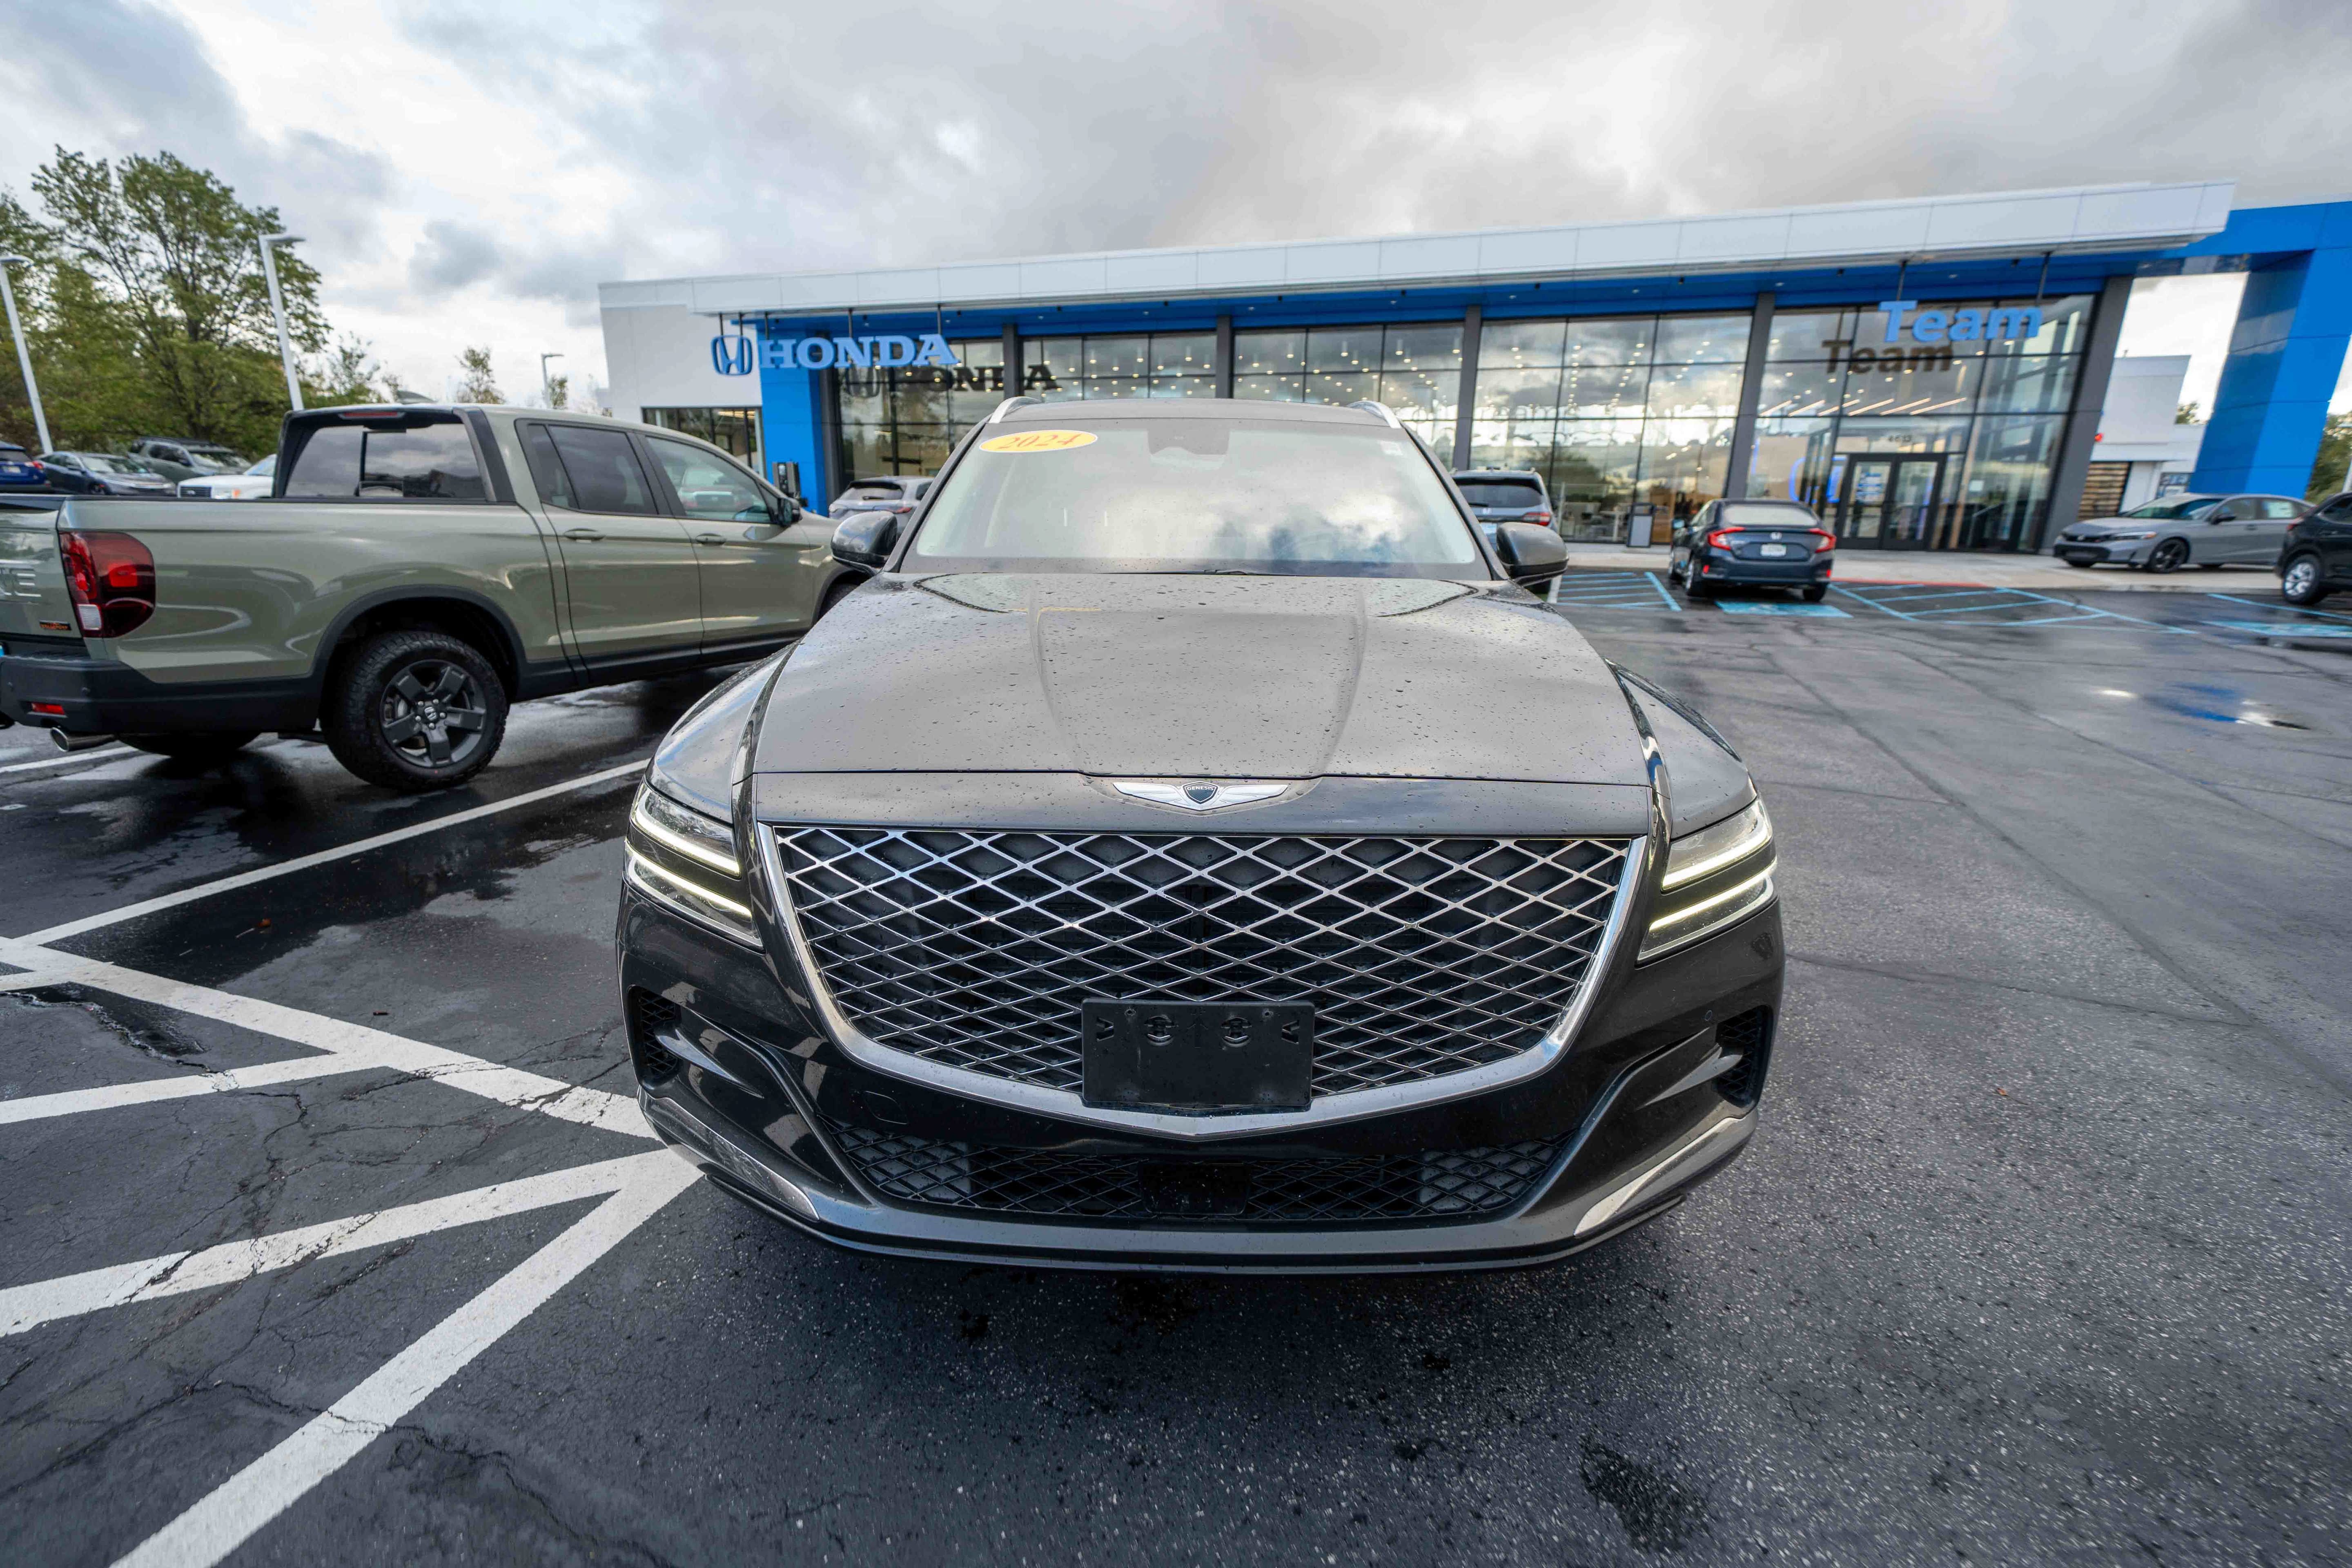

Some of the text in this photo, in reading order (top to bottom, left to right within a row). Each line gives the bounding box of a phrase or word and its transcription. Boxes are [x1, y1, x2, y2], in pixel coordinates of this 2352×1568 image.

[1879, 300, 2043, 343] Team
[760, 334, 961, 369] HONDA
[1822, 339, 1953, 374] Team
[997, 434, 1082, 449] 2024
